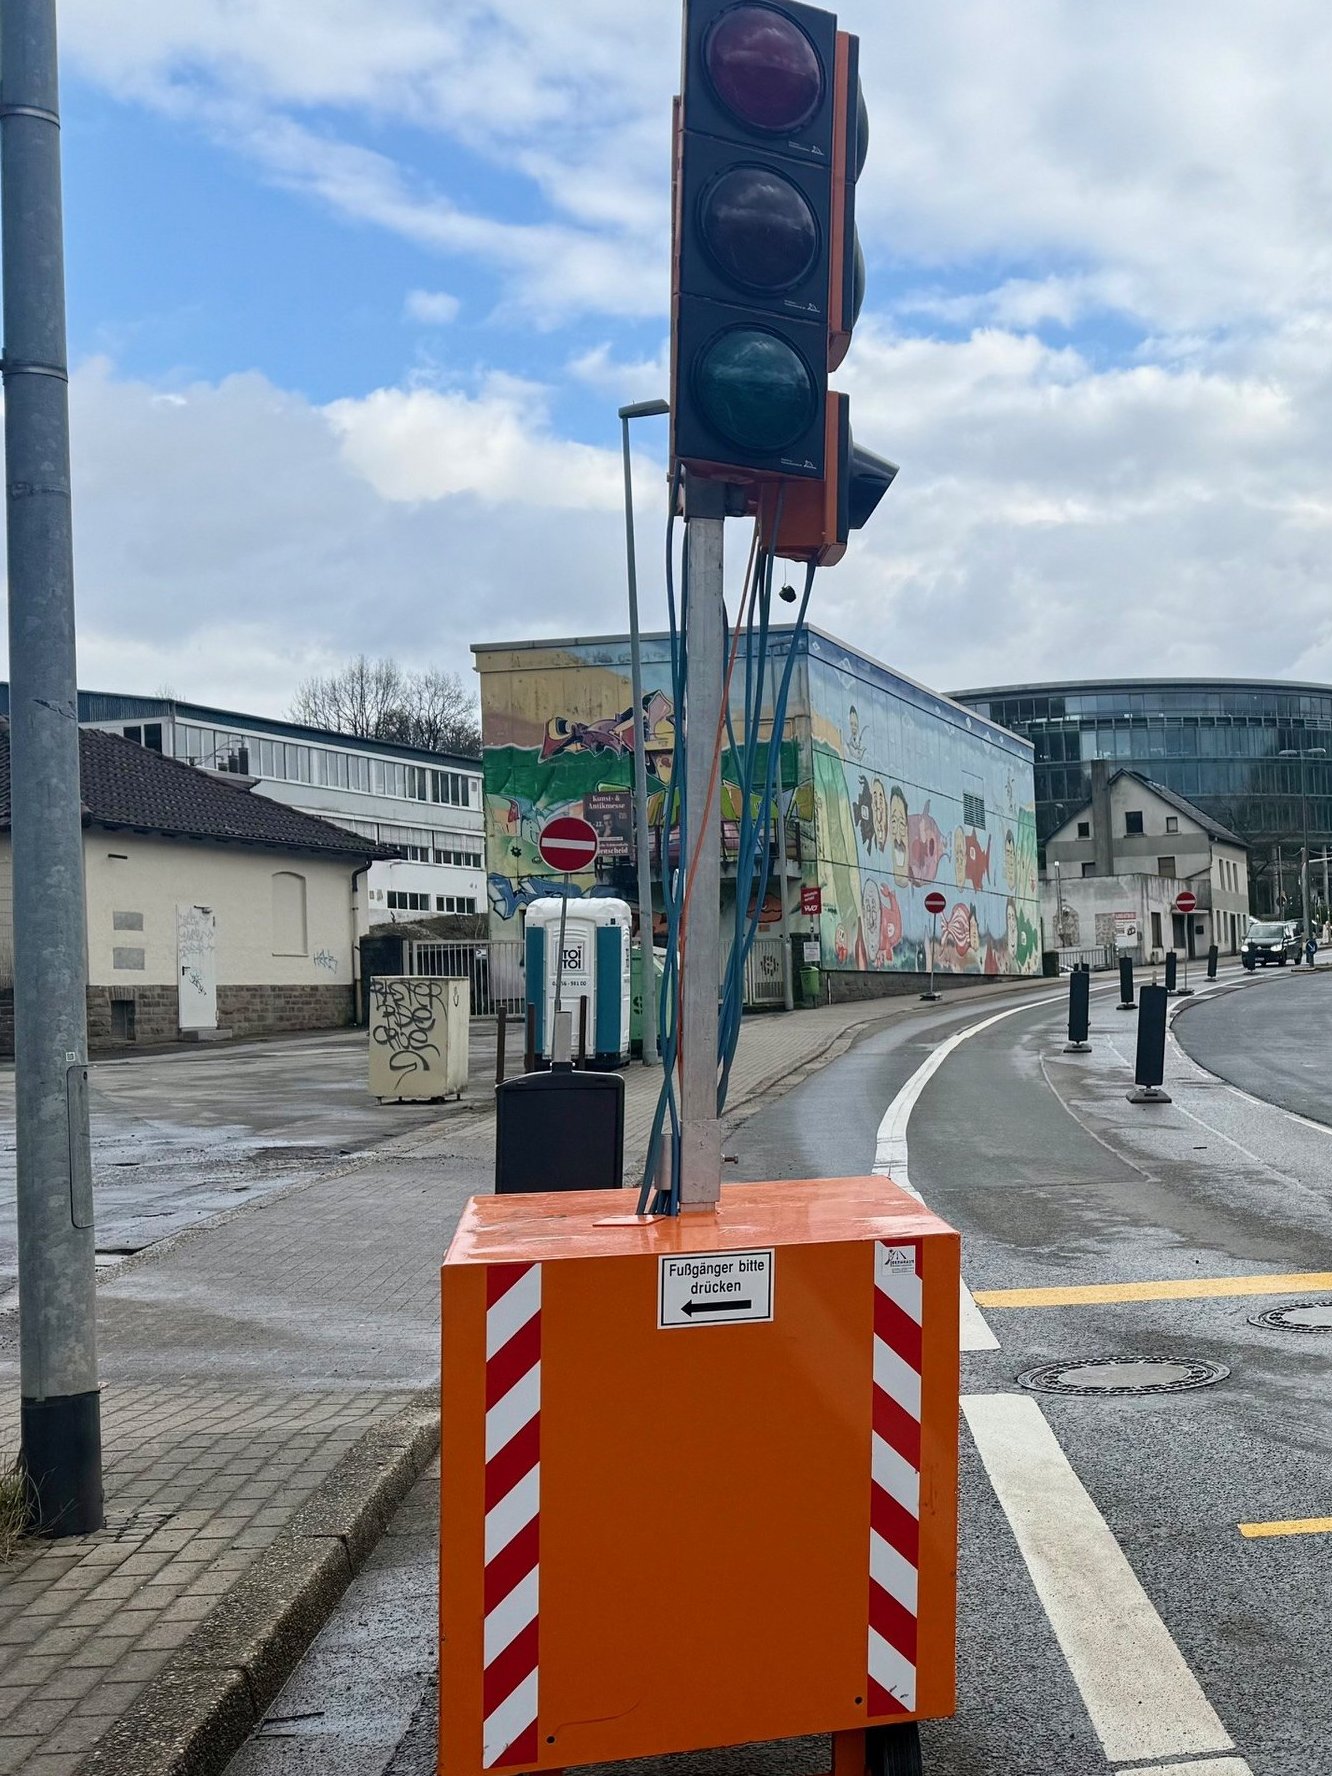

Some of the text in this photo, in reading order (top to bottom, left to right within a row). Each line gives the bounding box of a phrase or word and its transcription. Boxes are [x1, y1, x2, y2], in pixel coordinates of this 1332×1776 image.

[597, 846, 629, 854] enscheid
[669, 1259, 765, 1278] Fußgänger bitte
[690, 1280, 742, 1295] drücken
